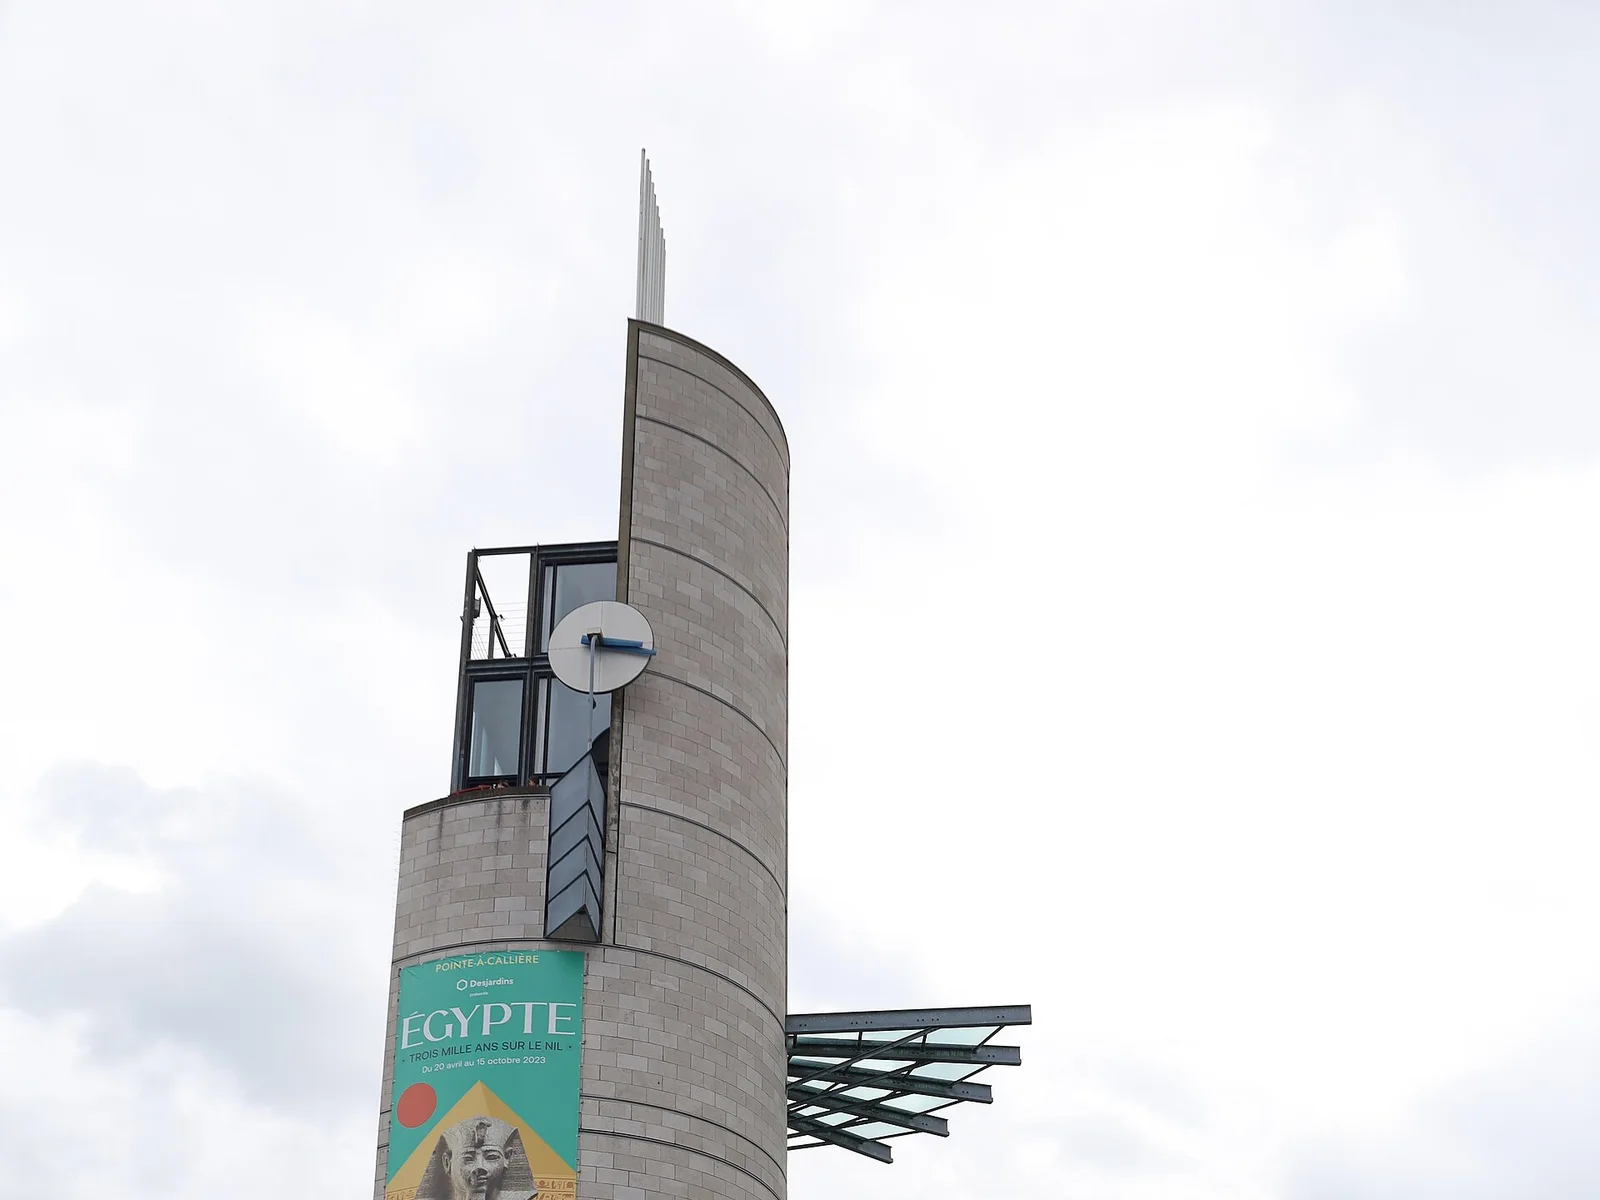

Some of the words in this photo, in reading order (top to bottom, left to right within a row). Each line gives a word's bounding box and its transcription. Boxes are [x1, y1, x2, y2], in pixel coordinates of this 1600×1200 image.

[435, 953, 539, 973] POINTE-À-CALLIÈRE
[470, 977, 514, 988] Desjardins
[401, 1001, 577, 1050] ÉGYPTE
[409, 1049, 439, 1063] TROIS
[441, 1044, 472, 1057] MILLE
[474, 1042, 499, 1052] ANS
[502, 1041, 525, 1051] SUR
[528, 1041, 542, 1050] LE
[545, 1041, 563, 1051] NIL
[422, 1065, 432, 1074] Du
[433, 1062, 445, 1072] 20
[446, 1060, 463, 1069] avril
[464, 1059, 474, 1067] au
[476, 1057, 486, 1066] 15
[487, 1056, 521, 1065] octobre
[522, 1056, 546, 1064] 2023
